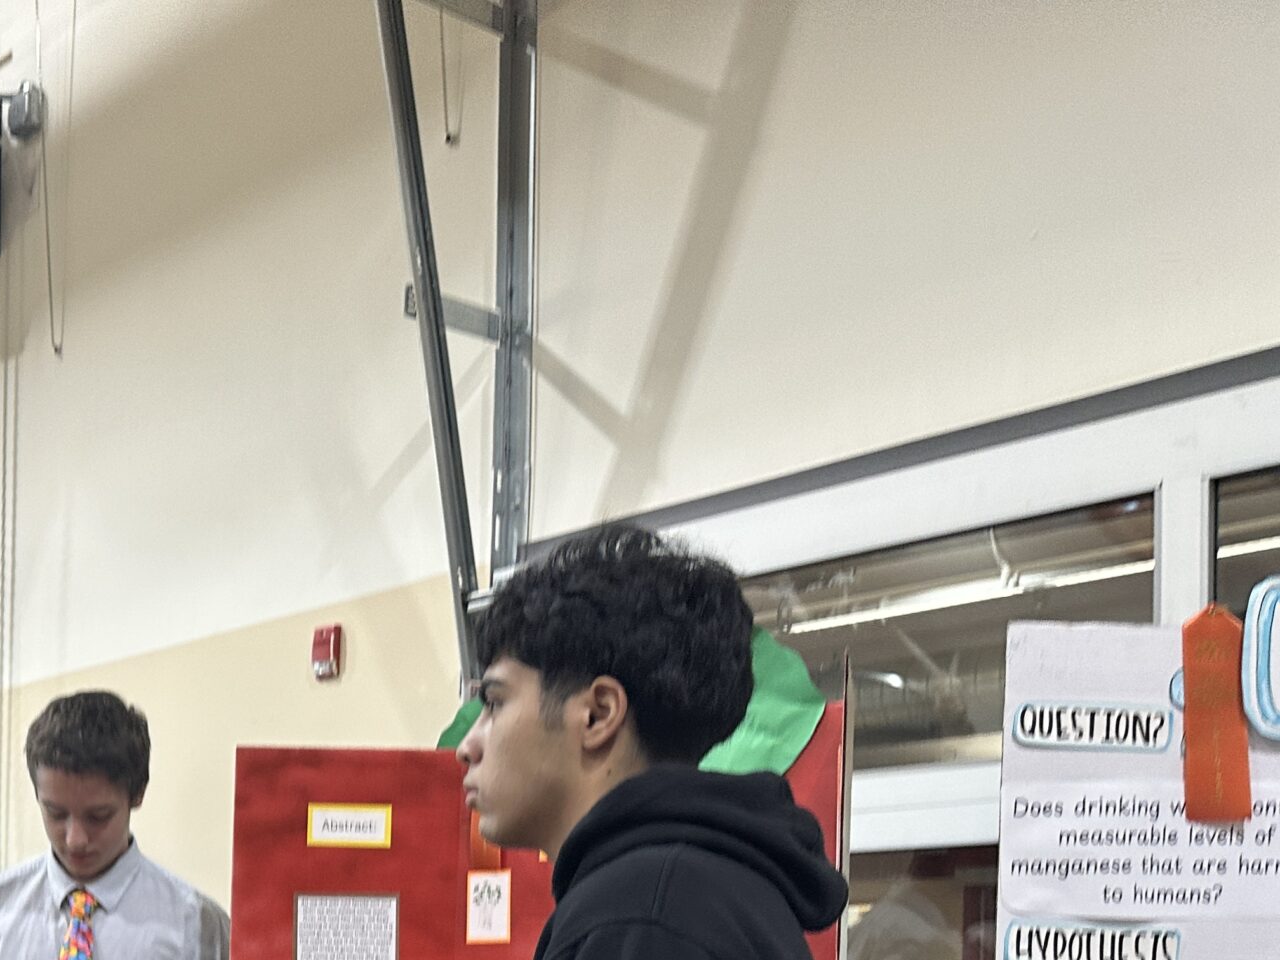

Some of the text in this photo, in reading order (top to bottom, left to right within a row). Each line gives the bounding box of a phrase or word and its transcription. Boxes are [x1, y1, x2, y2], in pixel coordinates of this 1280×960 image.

[1020, 705, 1165, 748] QUESTION?
[1013, 798, 1063, 818] Does
[1074, 796, 1160, 821] drinking
[1059, 823, 1277, 847] measurable levels of
[1010, 852, 1280, 880] manganese that are har
[1103, 883, 1223, 906] to humans?
